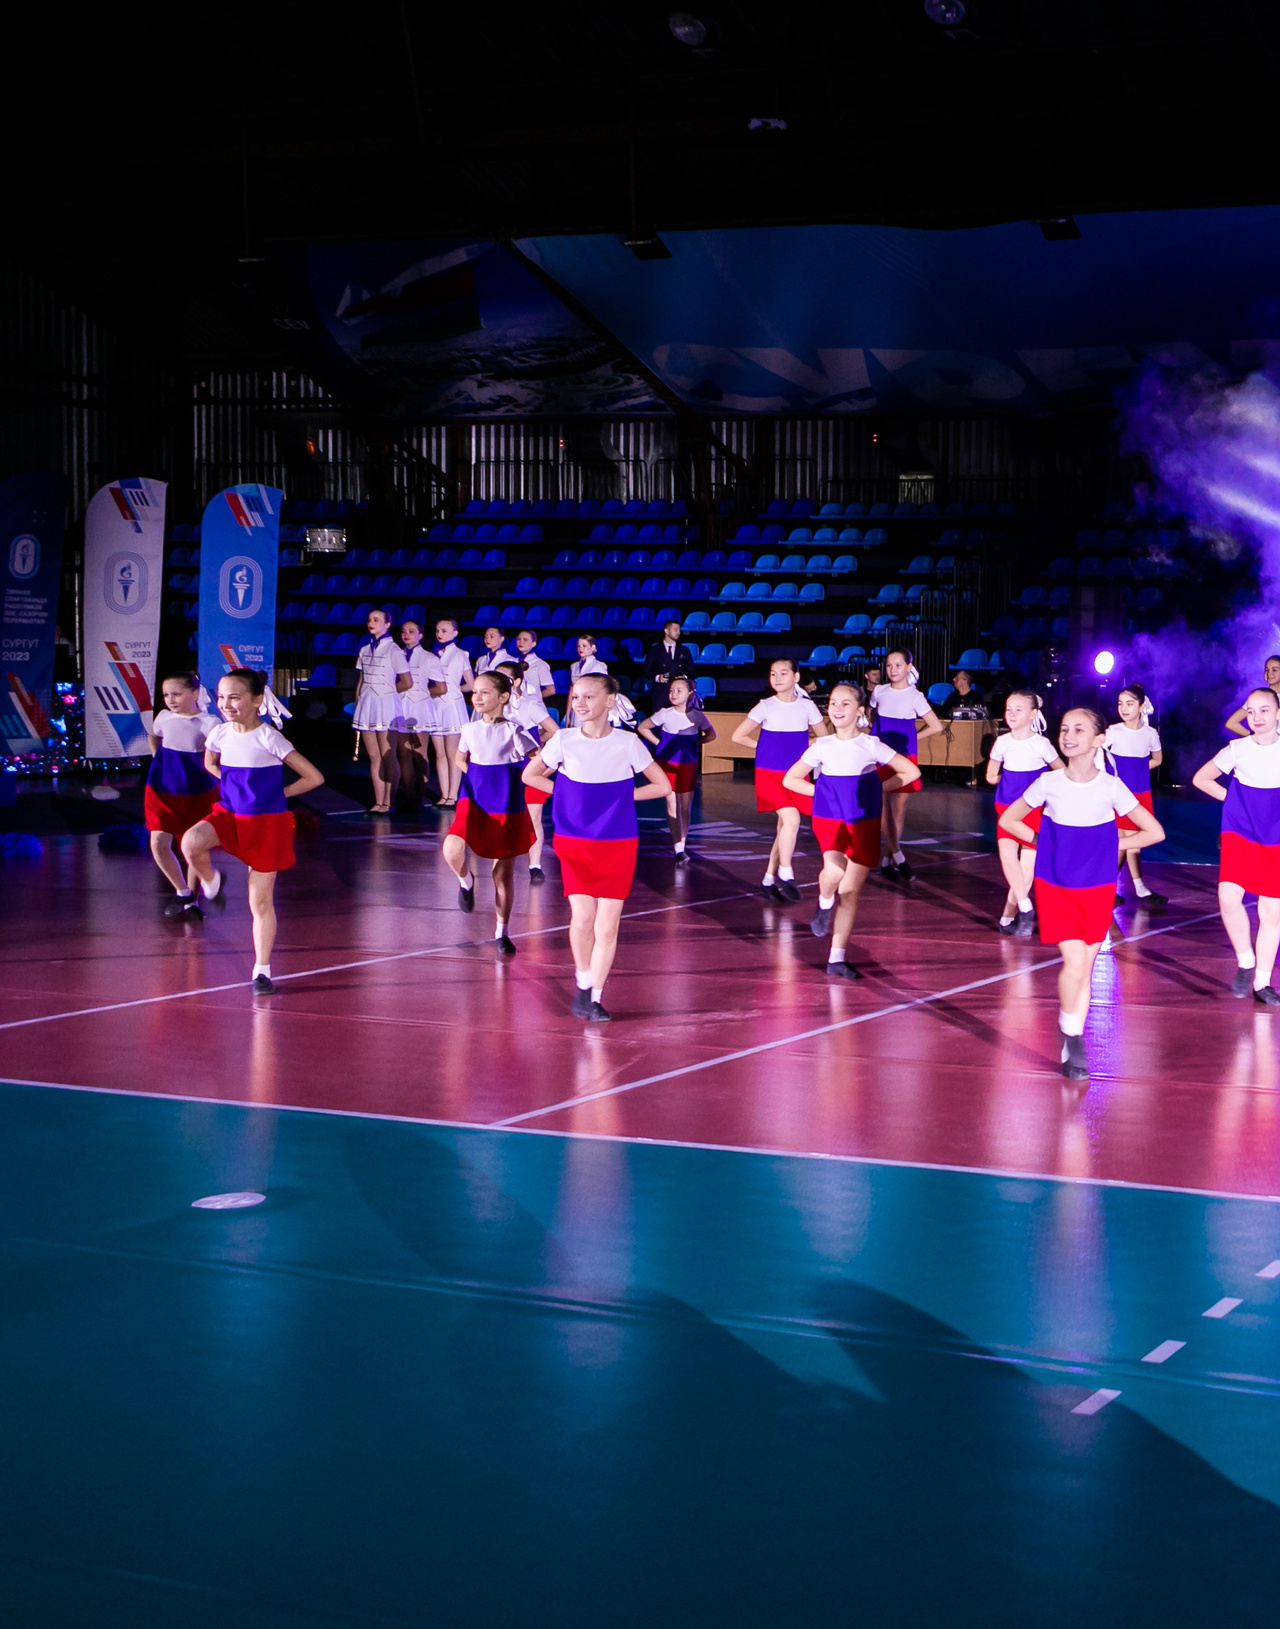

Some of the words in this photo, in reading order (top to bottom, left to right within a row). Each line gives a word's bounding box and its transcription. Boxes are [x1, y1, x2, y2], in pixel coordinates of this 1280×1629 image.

[2, 638, 40, 649] СУРГУТ
[125, 641, 151, 649] СУРГУТ
[238, 644, 264, 653] СУРГУТ
[2, 651, 30, 661] 2023
[131, 650, 151, 658] 2023
[245, 654, 264, 662] 2023
